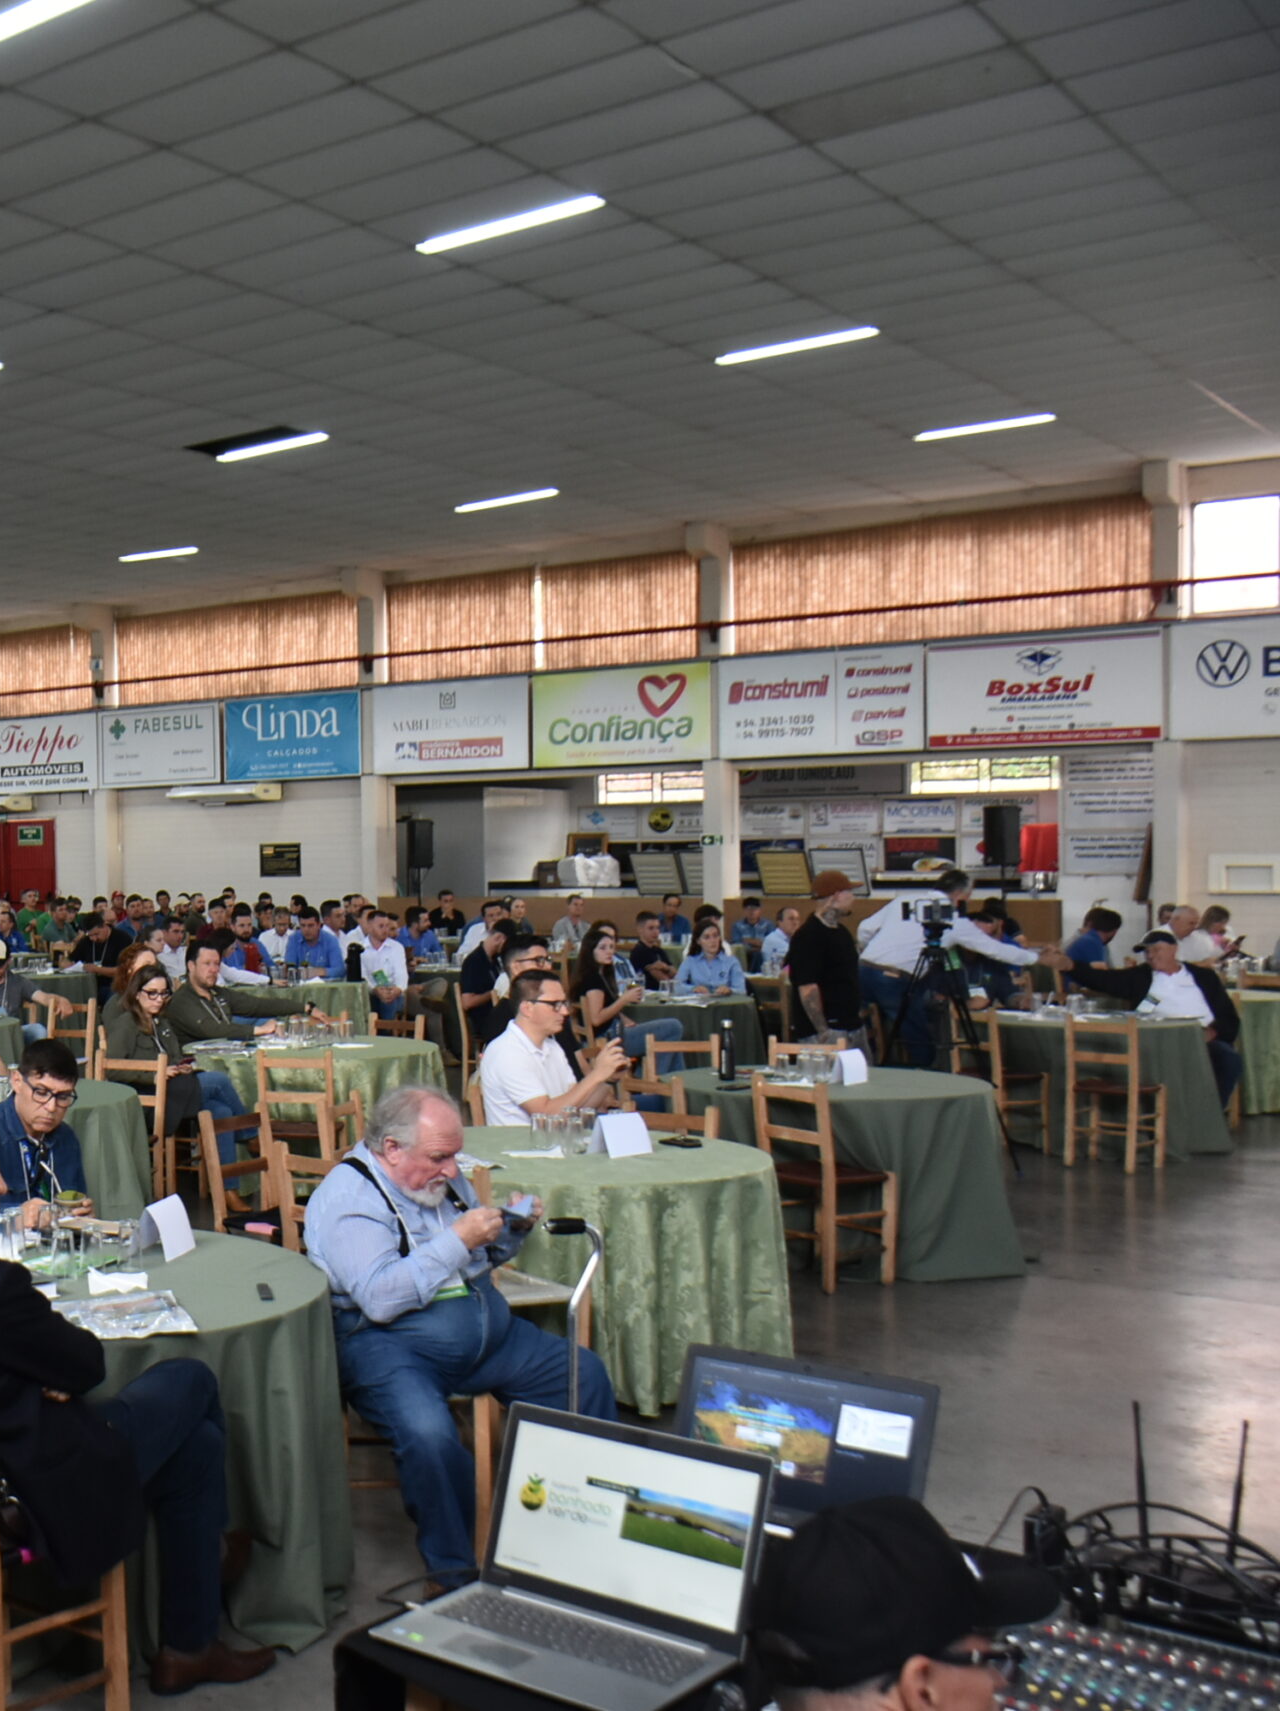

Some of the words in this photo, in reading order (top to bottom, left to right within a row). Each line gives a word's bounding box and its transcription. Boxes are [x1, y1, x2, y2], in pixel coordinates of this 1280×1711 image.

[855, 662, 913, 677] construmil
[743, 674, 829, 701] construmil
[985, 673, 1095, 697] BoxSul
[134, 714, 203, 734] FABESUL
[548, 715, 694, 745] Confiança
[266, 747, 318, 758] CALÇADOS
[422, 745, 501, 759] BERNARDON
[2, 763, 81, 777] AUTOMÓVEIS
[886, 805, 954, 818] MODERNA
